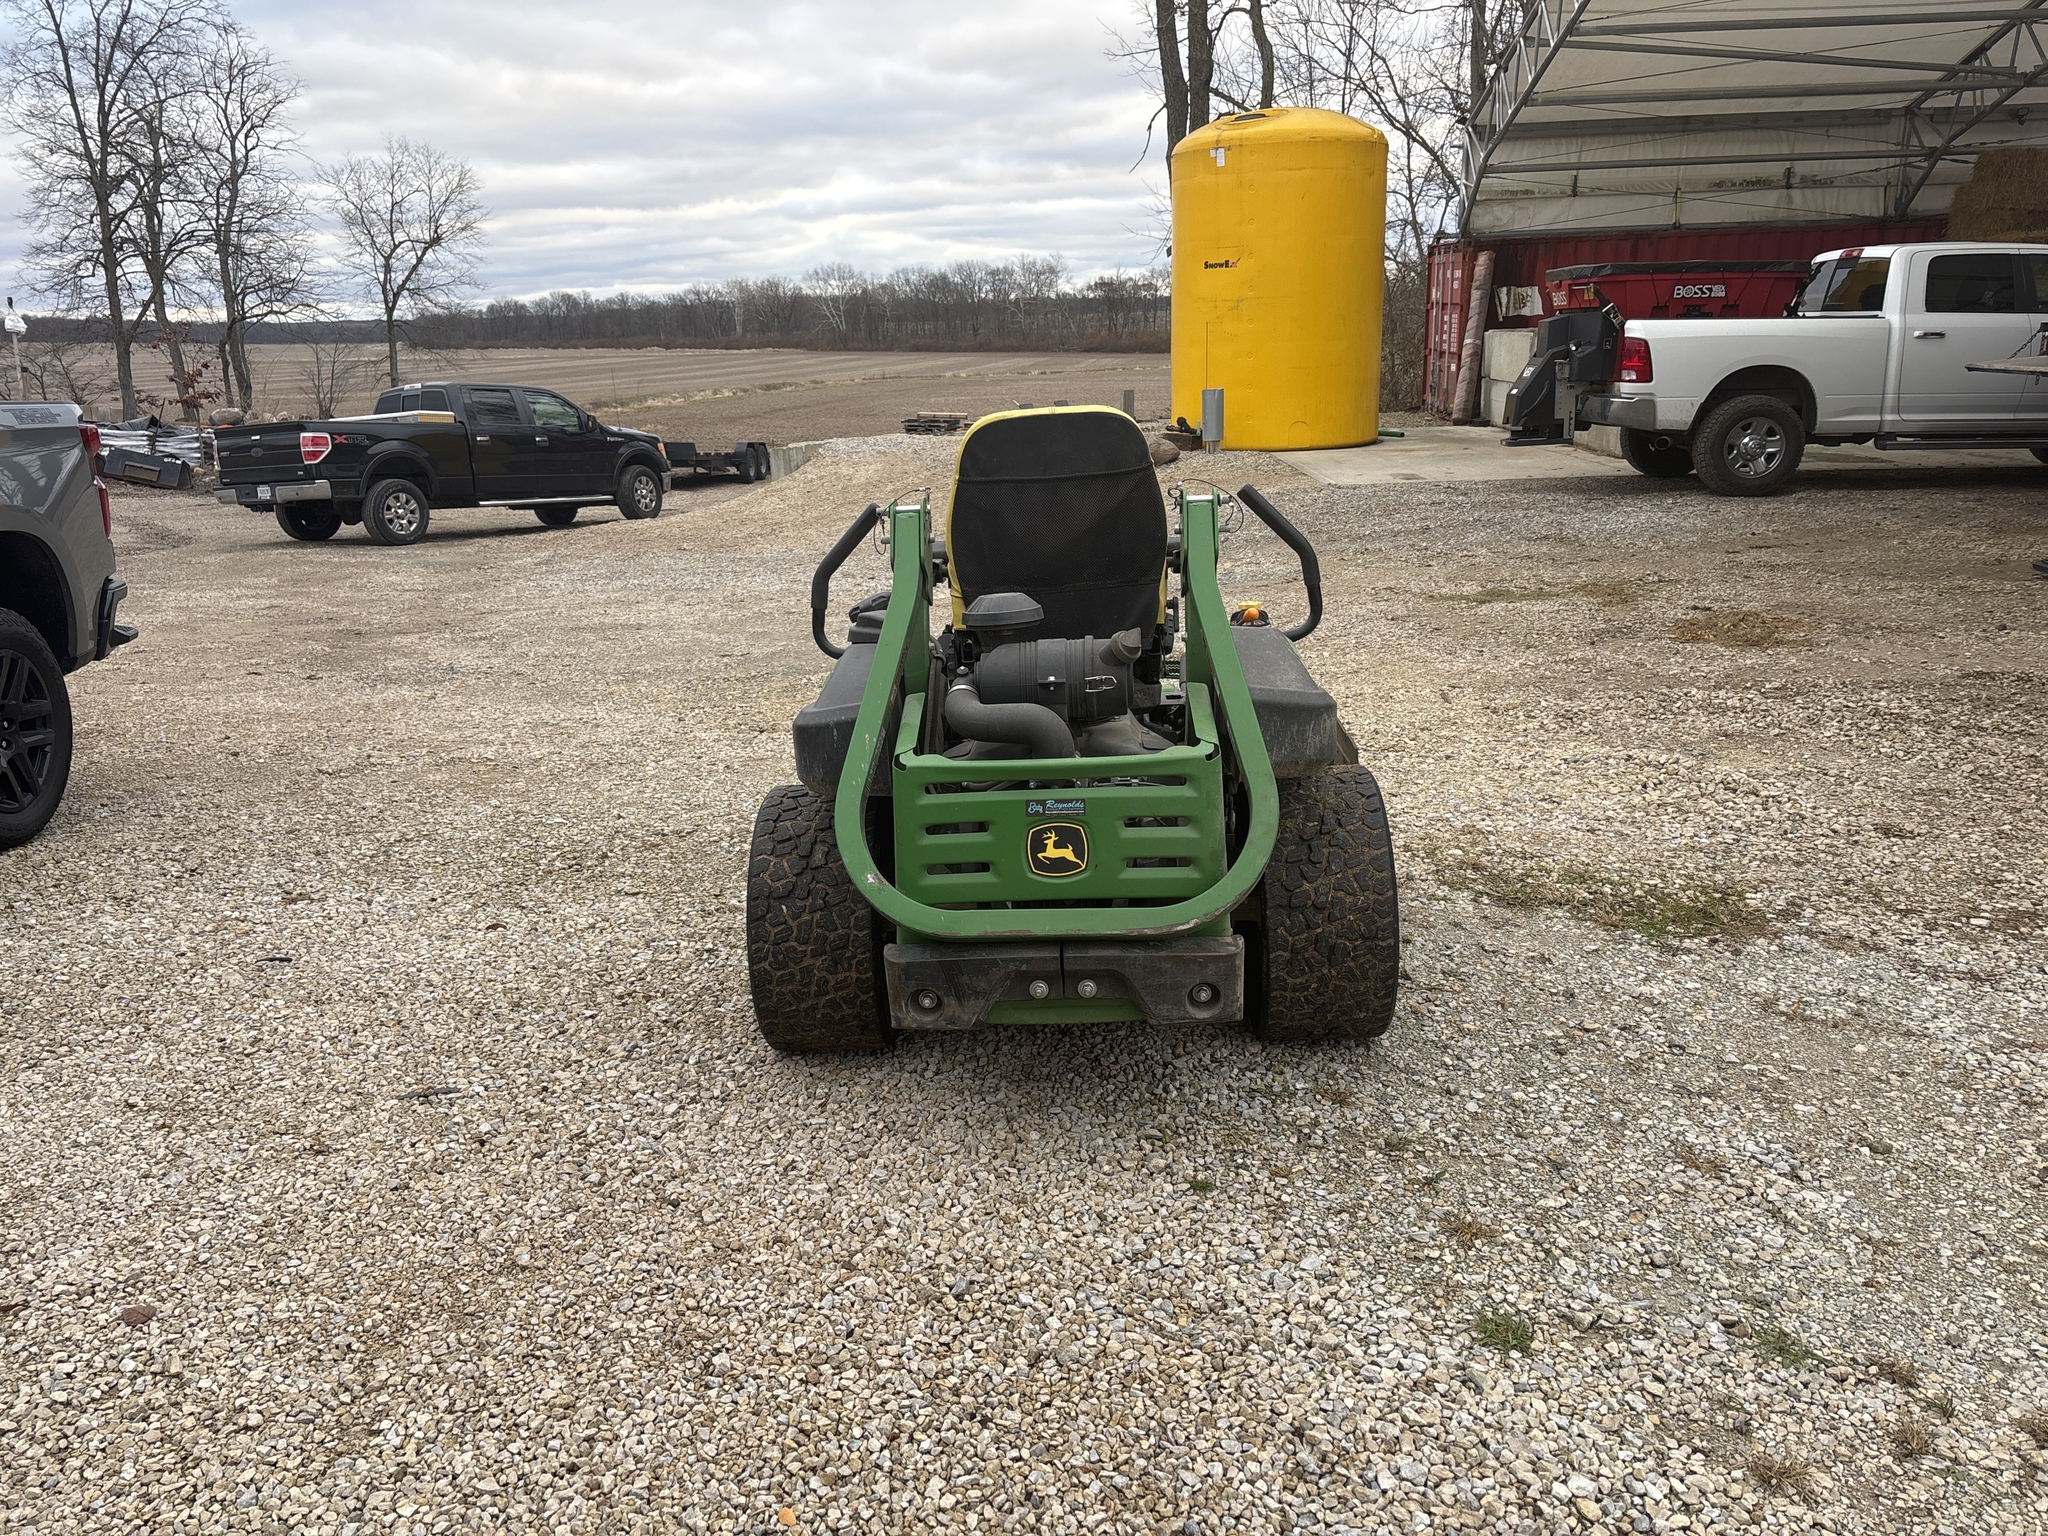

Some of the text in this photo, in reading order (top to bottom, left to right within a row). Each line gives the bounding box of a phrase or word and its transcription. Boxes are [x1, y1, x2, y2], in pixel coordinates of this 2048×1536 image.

[1673, 285, 1712, 298] BOSS
[1552, 291, 1567, 306] BOSS
[1, 408, 62, 418] TRAIL
[16, 416, 59, 425] BOSS
[333, 434, 367, 444] XTR
[1045, 800, 1085, 810] Reynolds
